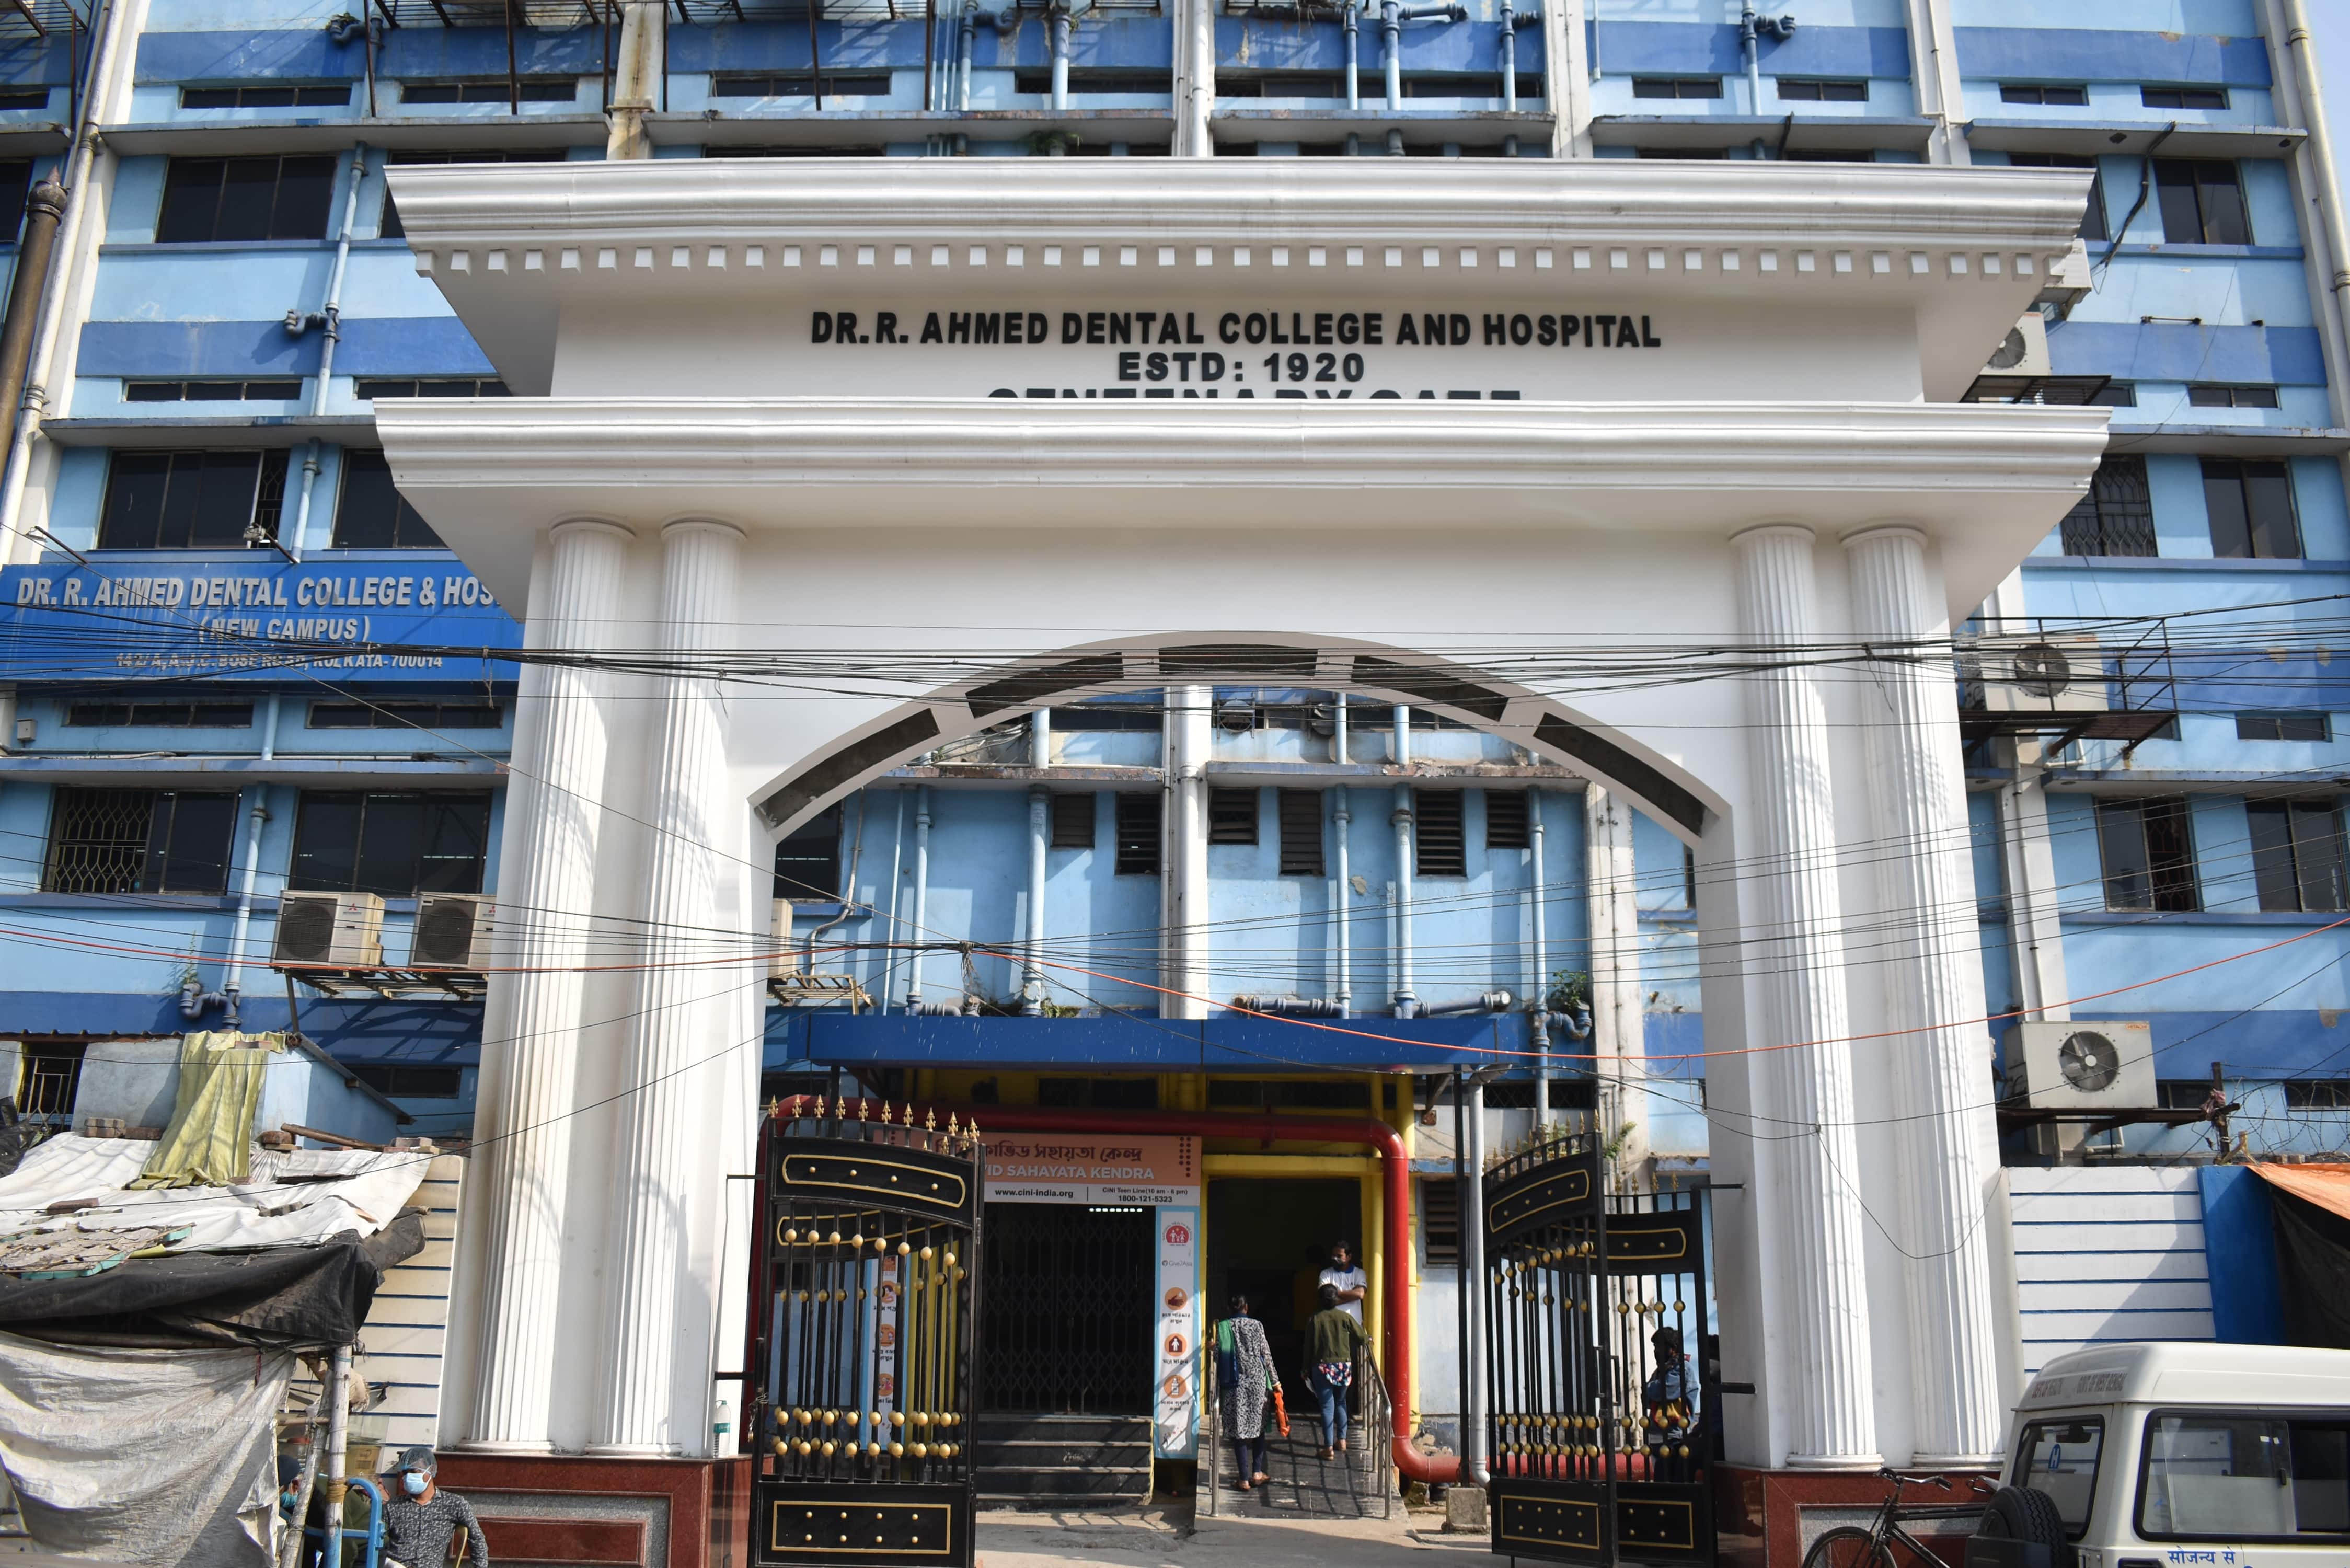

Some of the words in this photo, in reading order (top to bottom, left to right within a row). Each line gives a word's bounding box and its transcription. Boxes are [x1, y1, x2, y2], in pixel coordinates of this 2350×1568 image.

[919, 312, 1049, 344] AHMED
[1062, 312, 1204, 344] DENTAL
[1219, 312, 1383, 345] COLLEGE
[1396, 313, 1471, 346] AND
[1483, 314, 1663, 348] HOSPITAL
[1119, 352, 1243, 381] ESTD:
[1264, 352, 1365, 382] 1920
[17, 578, 56, 606] DR.
[63, 578, 87, 606] R.
[93, 577, 184, 607] AHMED
[190, 577, 288, 606] DENTAL
[297, 577, 414, 607] COLLEGE
[419, 577, 435, 605] &
[443, 576, 502, 605] HOS
[1007, 1165, 1087, 1178] SAHAYATA
[1091, 1167, 1155, 1179] KENDRA
[995, 1188, 1074, 1199] www.cini-india.org
[1118, 1195, 1173, 1203] 1800-121-5323
[2221, 1545, 2236, 1564] से
